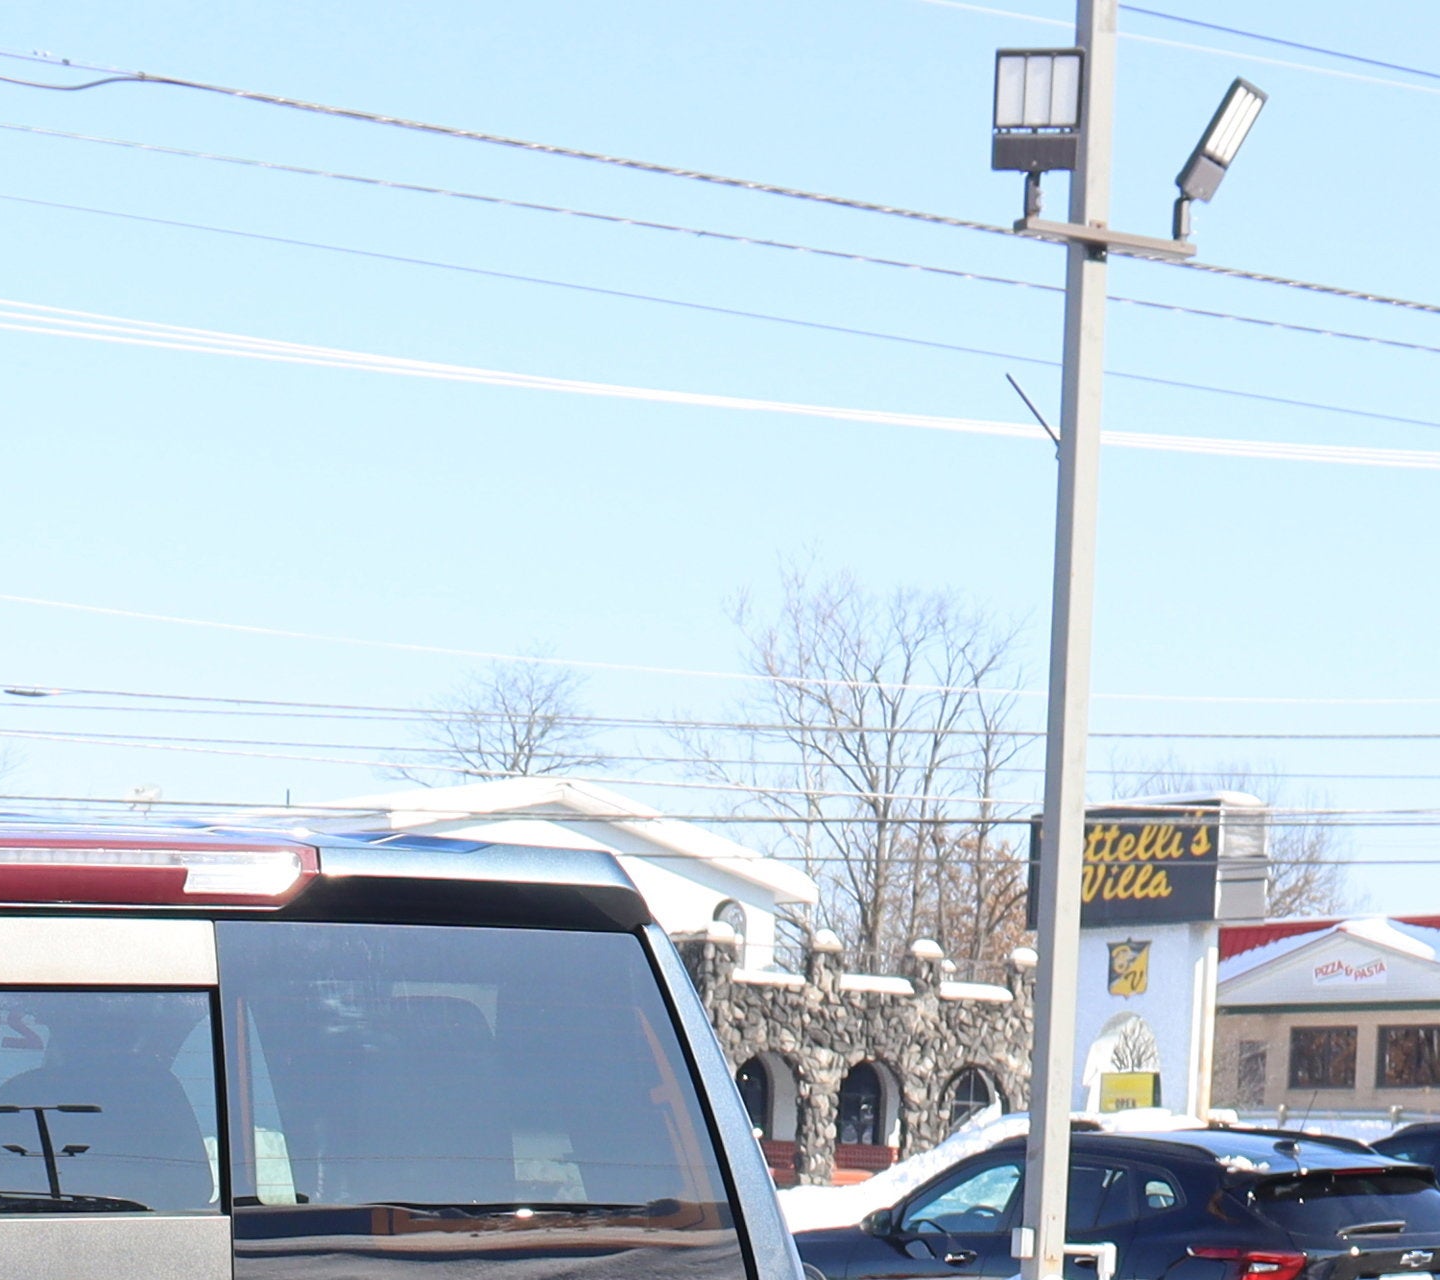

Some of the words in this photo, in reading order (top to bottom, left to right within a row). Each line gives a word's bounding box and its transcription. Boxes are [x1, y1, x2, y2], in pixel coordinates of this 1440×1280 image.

[1039, 809, 1212, 862] ttelli's
[1081, 863, 1172, 902] Villa
[1315, 960, 1344, 978] PIZZA
[1354, 962, 1386, 981] PASTA
